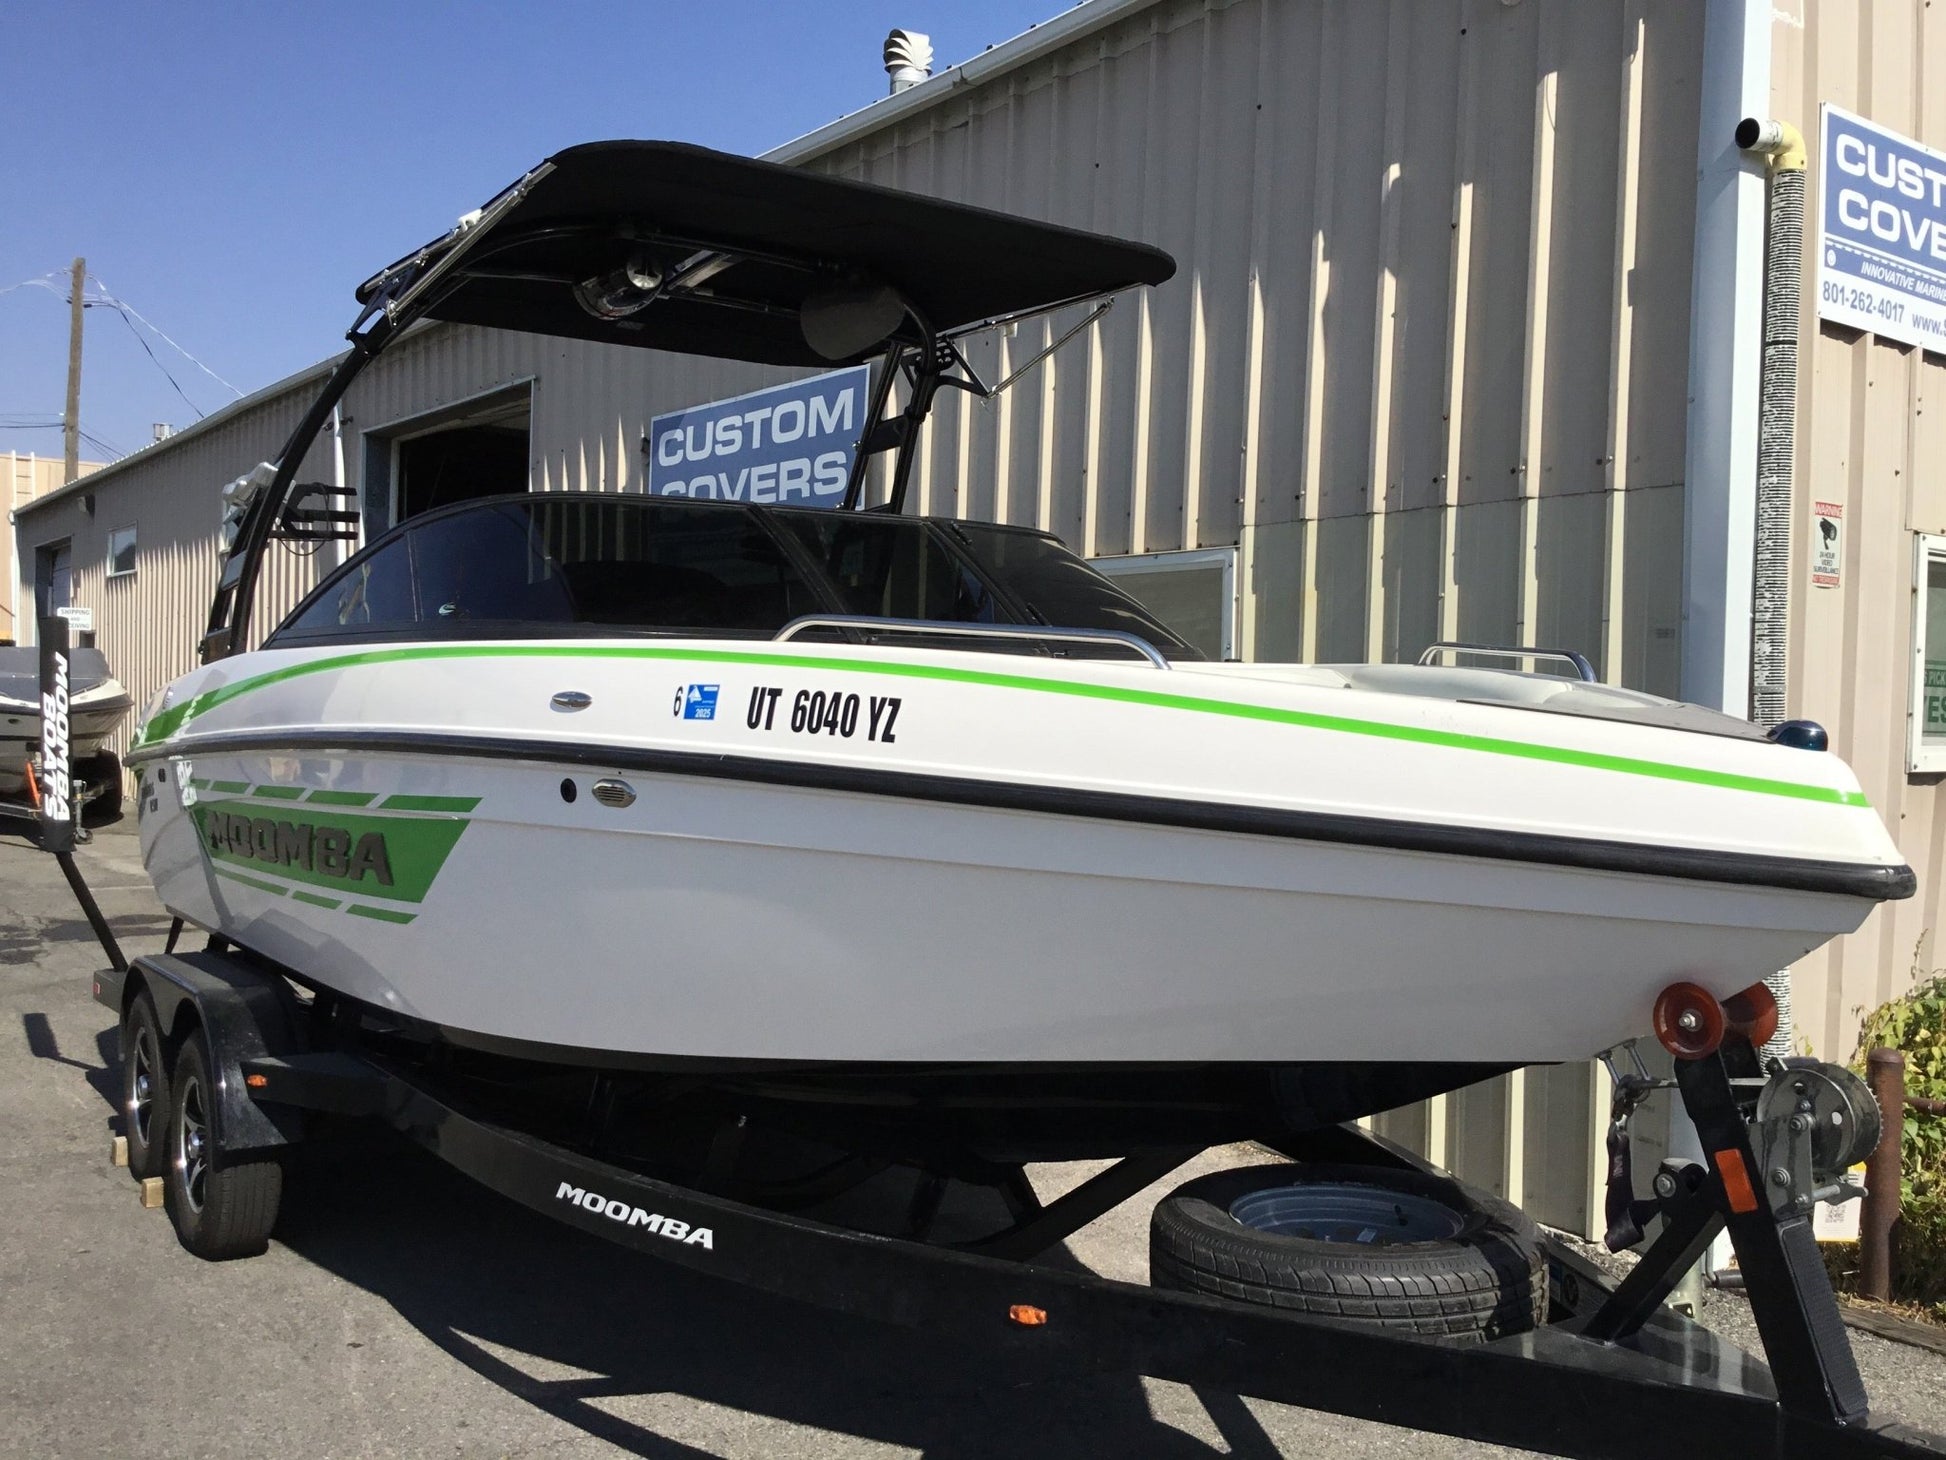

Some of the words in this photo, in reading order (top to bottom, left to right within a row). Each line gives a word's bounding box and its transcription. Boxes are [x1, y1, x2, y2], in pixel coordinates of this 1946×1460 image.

[1836, 133, 1946, 208] CUST
[1823, 280, 1905, 323] 801-262-4017
[1861, 261, 1915, 291] INNOVATIVE
[658, 387, 854, 467] CUSTOM
[54, 651, 71, 821] MOOMBA
[673, 686, 684, 717] 6
[695, 708, 711, 718] 2025
[747, 686, 783, 730] UT
[790, 689, 860, 738] 6040
[868, 696, 902, 743] YZ
[42, 691, 57, 821] BOATS
[205, 809, 395, 887] MOOMBA
[555, 1181, 713, 1250] MOOMBA
